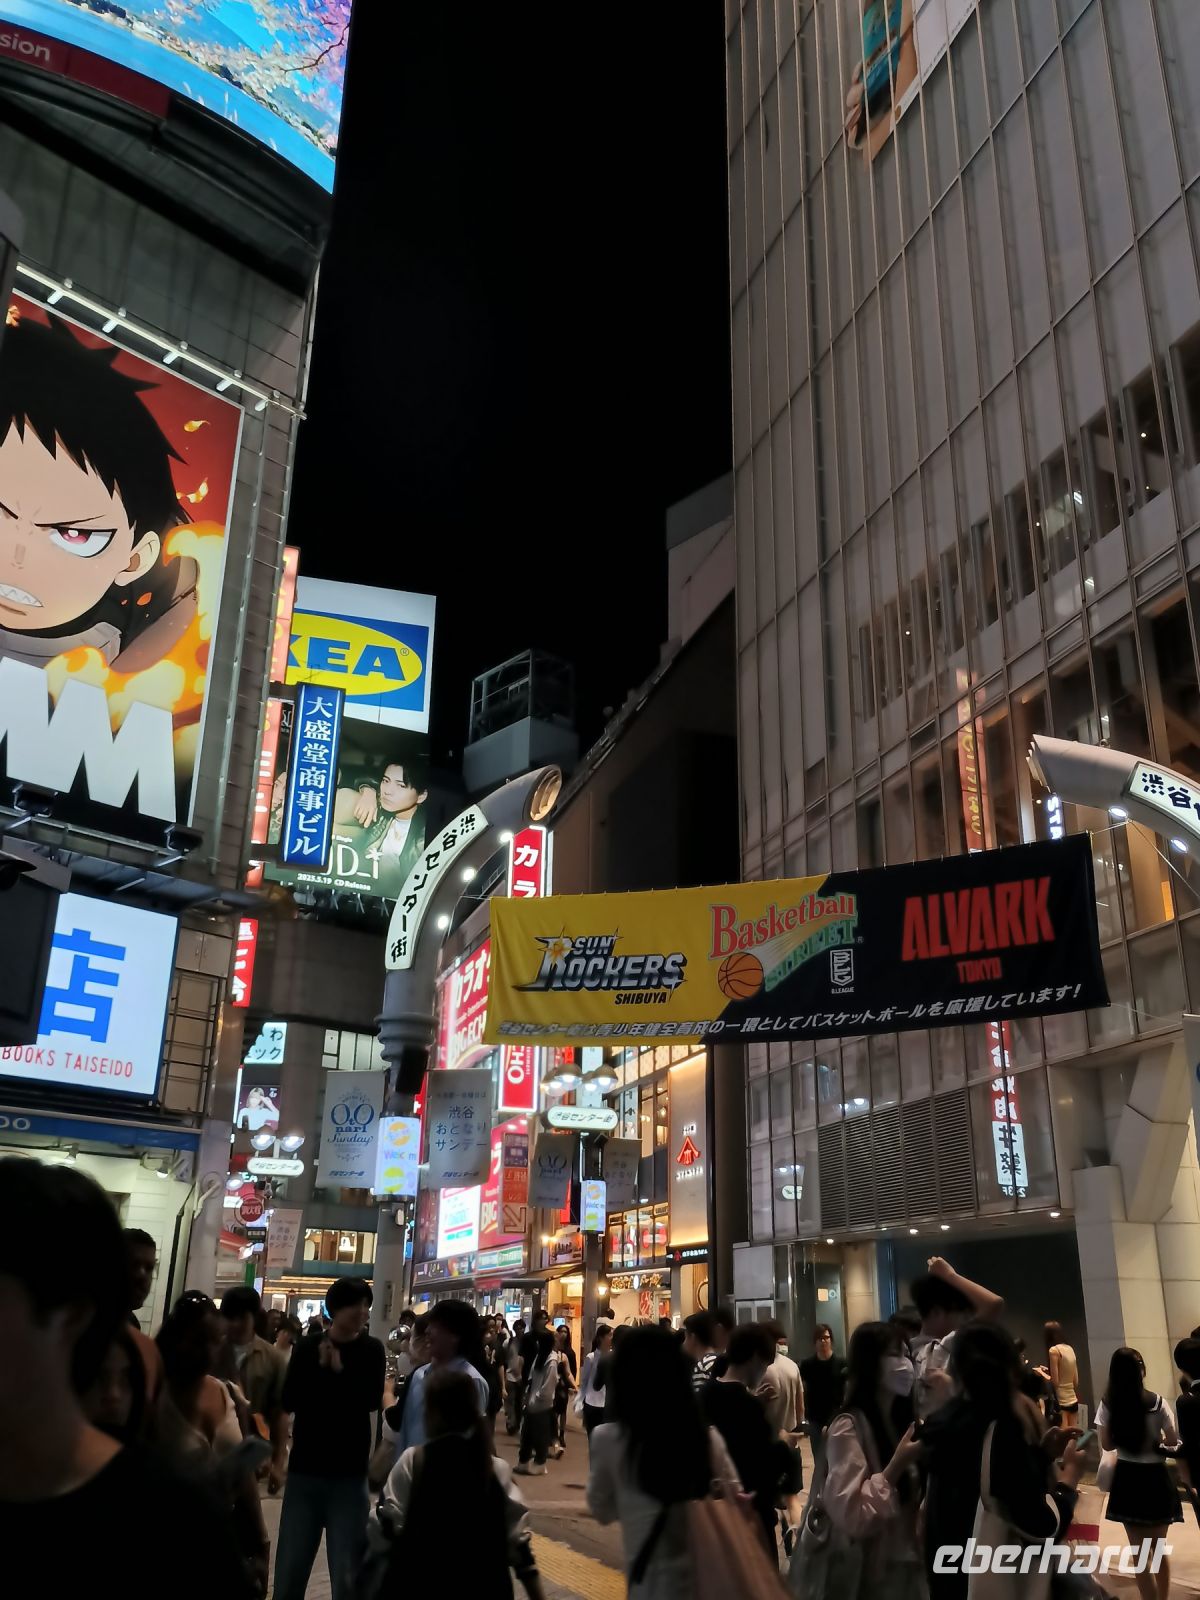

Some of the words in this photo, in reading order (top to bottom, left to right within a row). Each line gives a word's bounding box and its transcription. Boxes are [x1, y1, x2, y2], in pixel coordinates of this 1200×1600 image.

[291, 696, 334, 856] 大盛堂商事ビル
[391, 813, 476, 963] 渋谷センター街
[711, 892, 855, 959] Basketball
[902, 876, 1055, 961] ALVARK
[573, 934, 616, 956] SUN
[512, 935, 687, 992] ROCKERS
[957, 957, 1002, 983] TOKYO
[614, 991, 667, 1005] SHIBUYA
[2, 1045, 56, 1067] BOOKS
[65, 1052, 133, 1078] TAISEIDO
[246, 1047, 281, 1060] ック
[448, 1105, 474, 1119] 渋谷
[327, 1133, 374, 1146] Sunday
